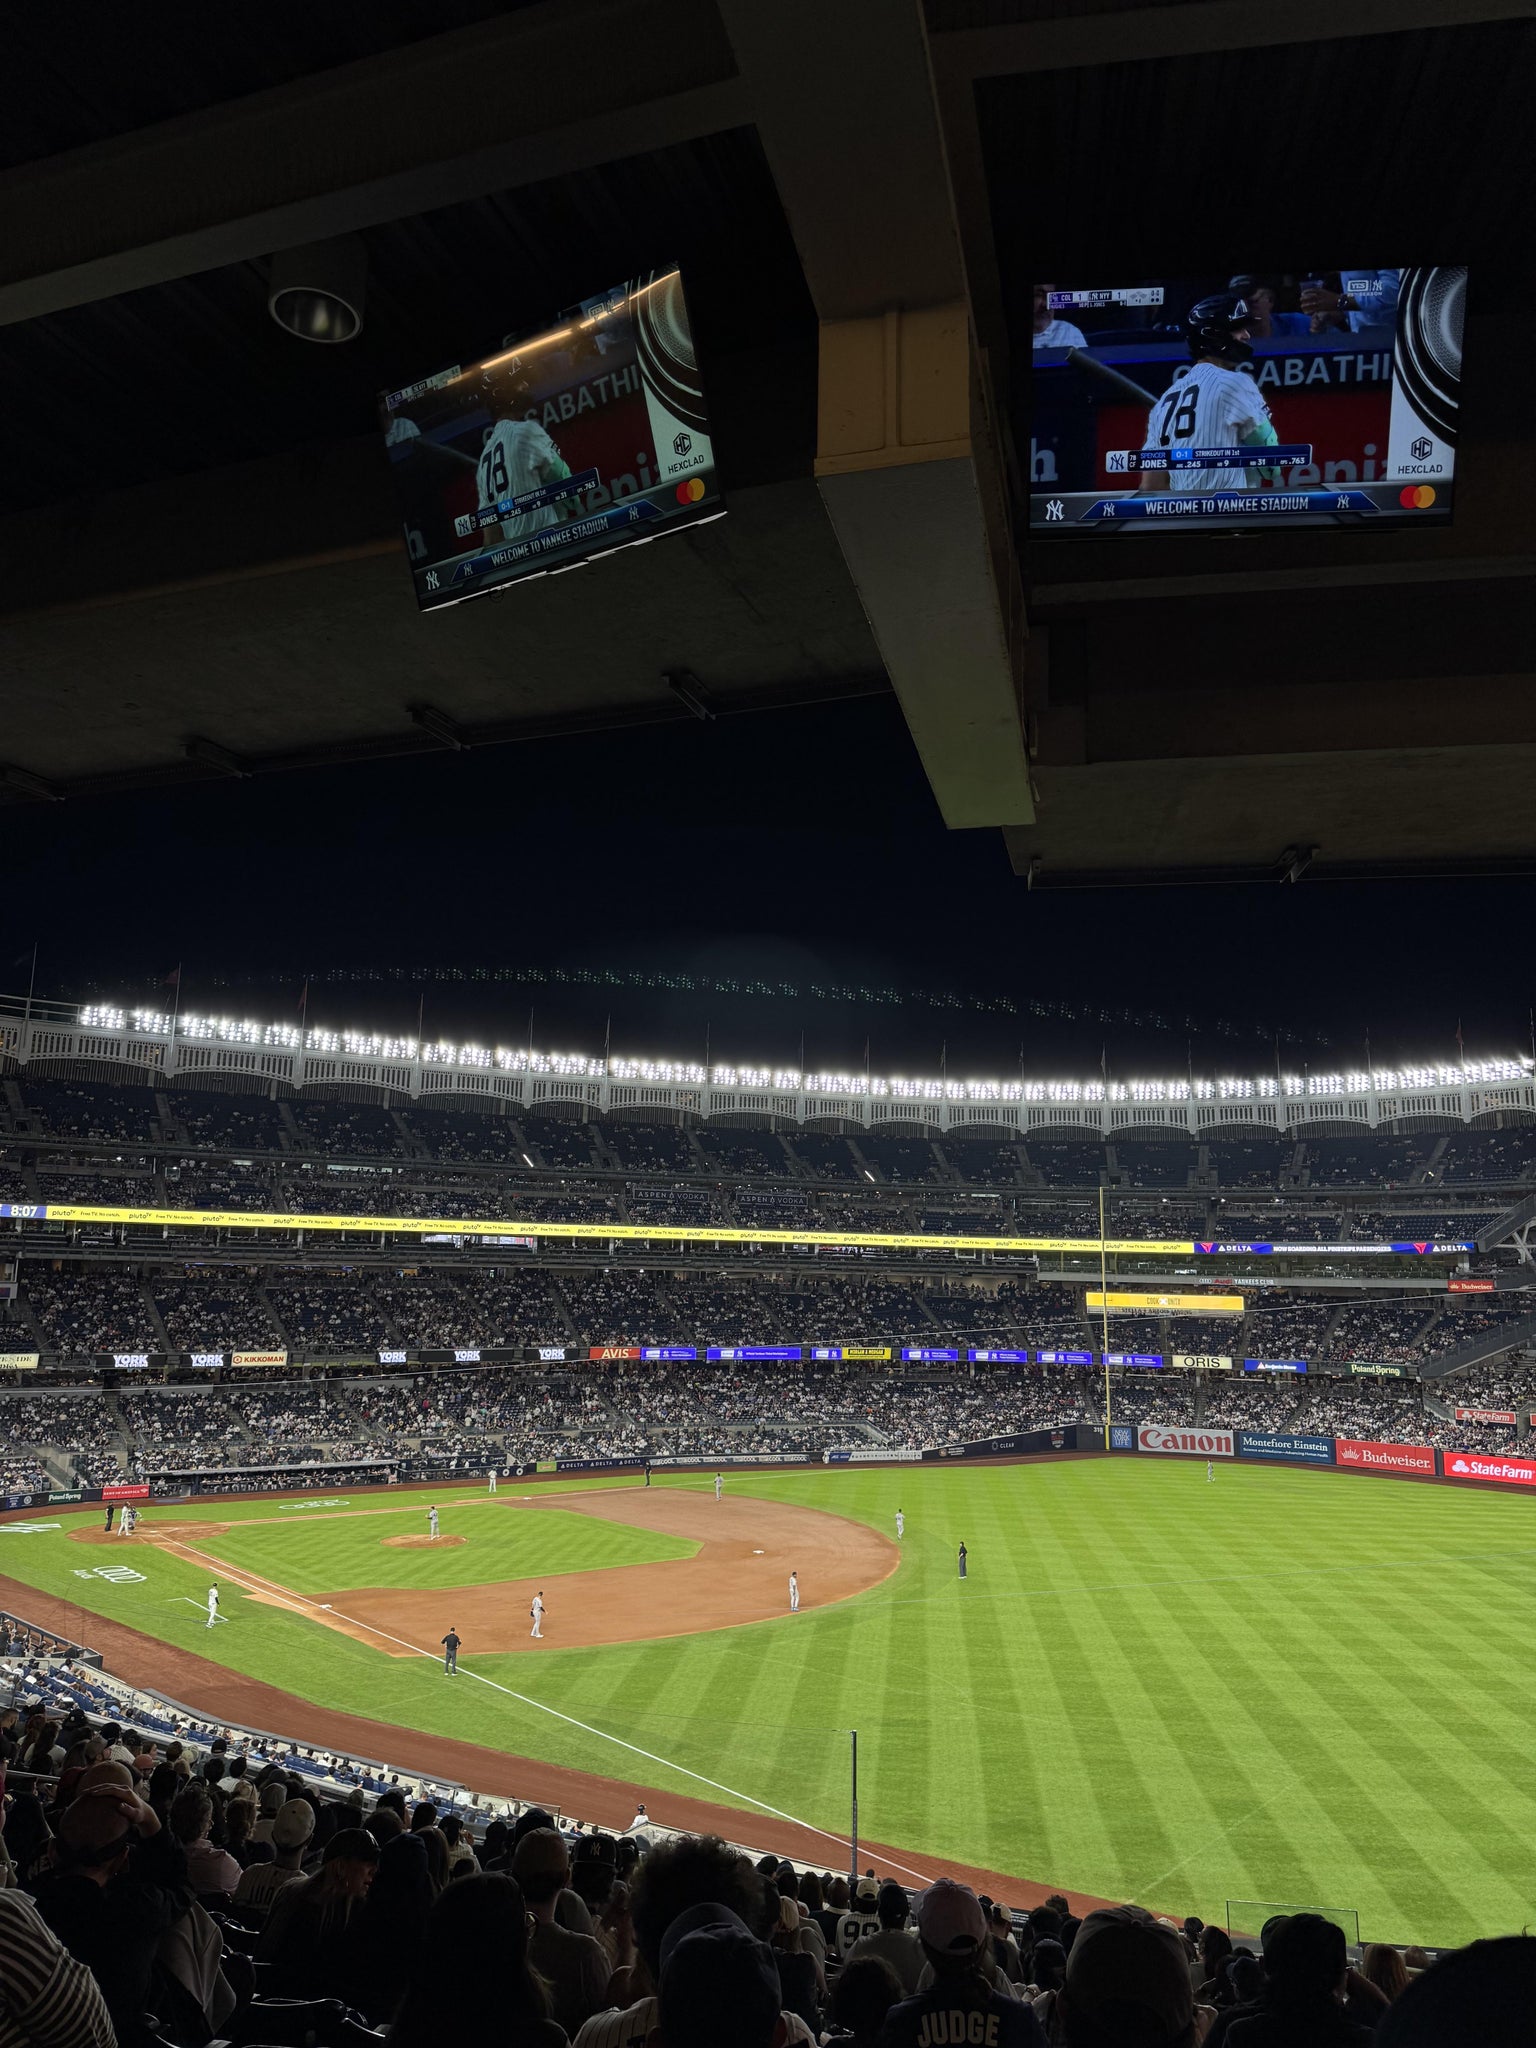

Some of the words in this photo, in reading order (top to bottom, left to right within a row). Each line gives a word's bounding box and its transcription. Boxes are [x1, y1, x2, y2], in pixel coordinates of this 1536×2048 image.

[1159, 384, 1200, 446] 78
[668, 454, 705, 474] HEXCLAD
[1140, 460, 1167, 469] JONES
[1398, 464, 1443, 474] HEXCLAD
[481, 441, 509, 503] 78
[1146, 501, 1198, 514] WELCOME
[1202, 500, 1214, 513] TO
[1216, 498, 1258, 512] YANKEE
[1260, 497, 1308, 511] STADIUM
[479, 514, 498, 527] JONES
[491, 544, 530, 566] WELCOME
[530, 542, 540, 554] TO
[542, 530, 571, 552] YANKEE
[573, 517, 609, 540] STADIUM
[10, 1205, 38, 1217] 8:07
[379, 1351, 407, 1360] YORK
[454, 1350, 481, 1359] YORK
[539, 1348, 565, 1357] YORK
[602, 1349, 629, 1358] AVIS
[113, 1354, 148, 1364] YORK
[190, 1354, 224, 1364] YORK
[1184, 1357, 1220, 1368] ORIS
[1351, 1364, 1375, 1374] Poland
[1376, 1365, 1400, 1376] Spring
[1140, 1429, 1232, 1452] Canon
[1242, 1436, 1291, 1448] Montefiore
[1294, 1440, 1328, 1452] Einstein
[917, 2010, 1000, 2048] JUDGE
